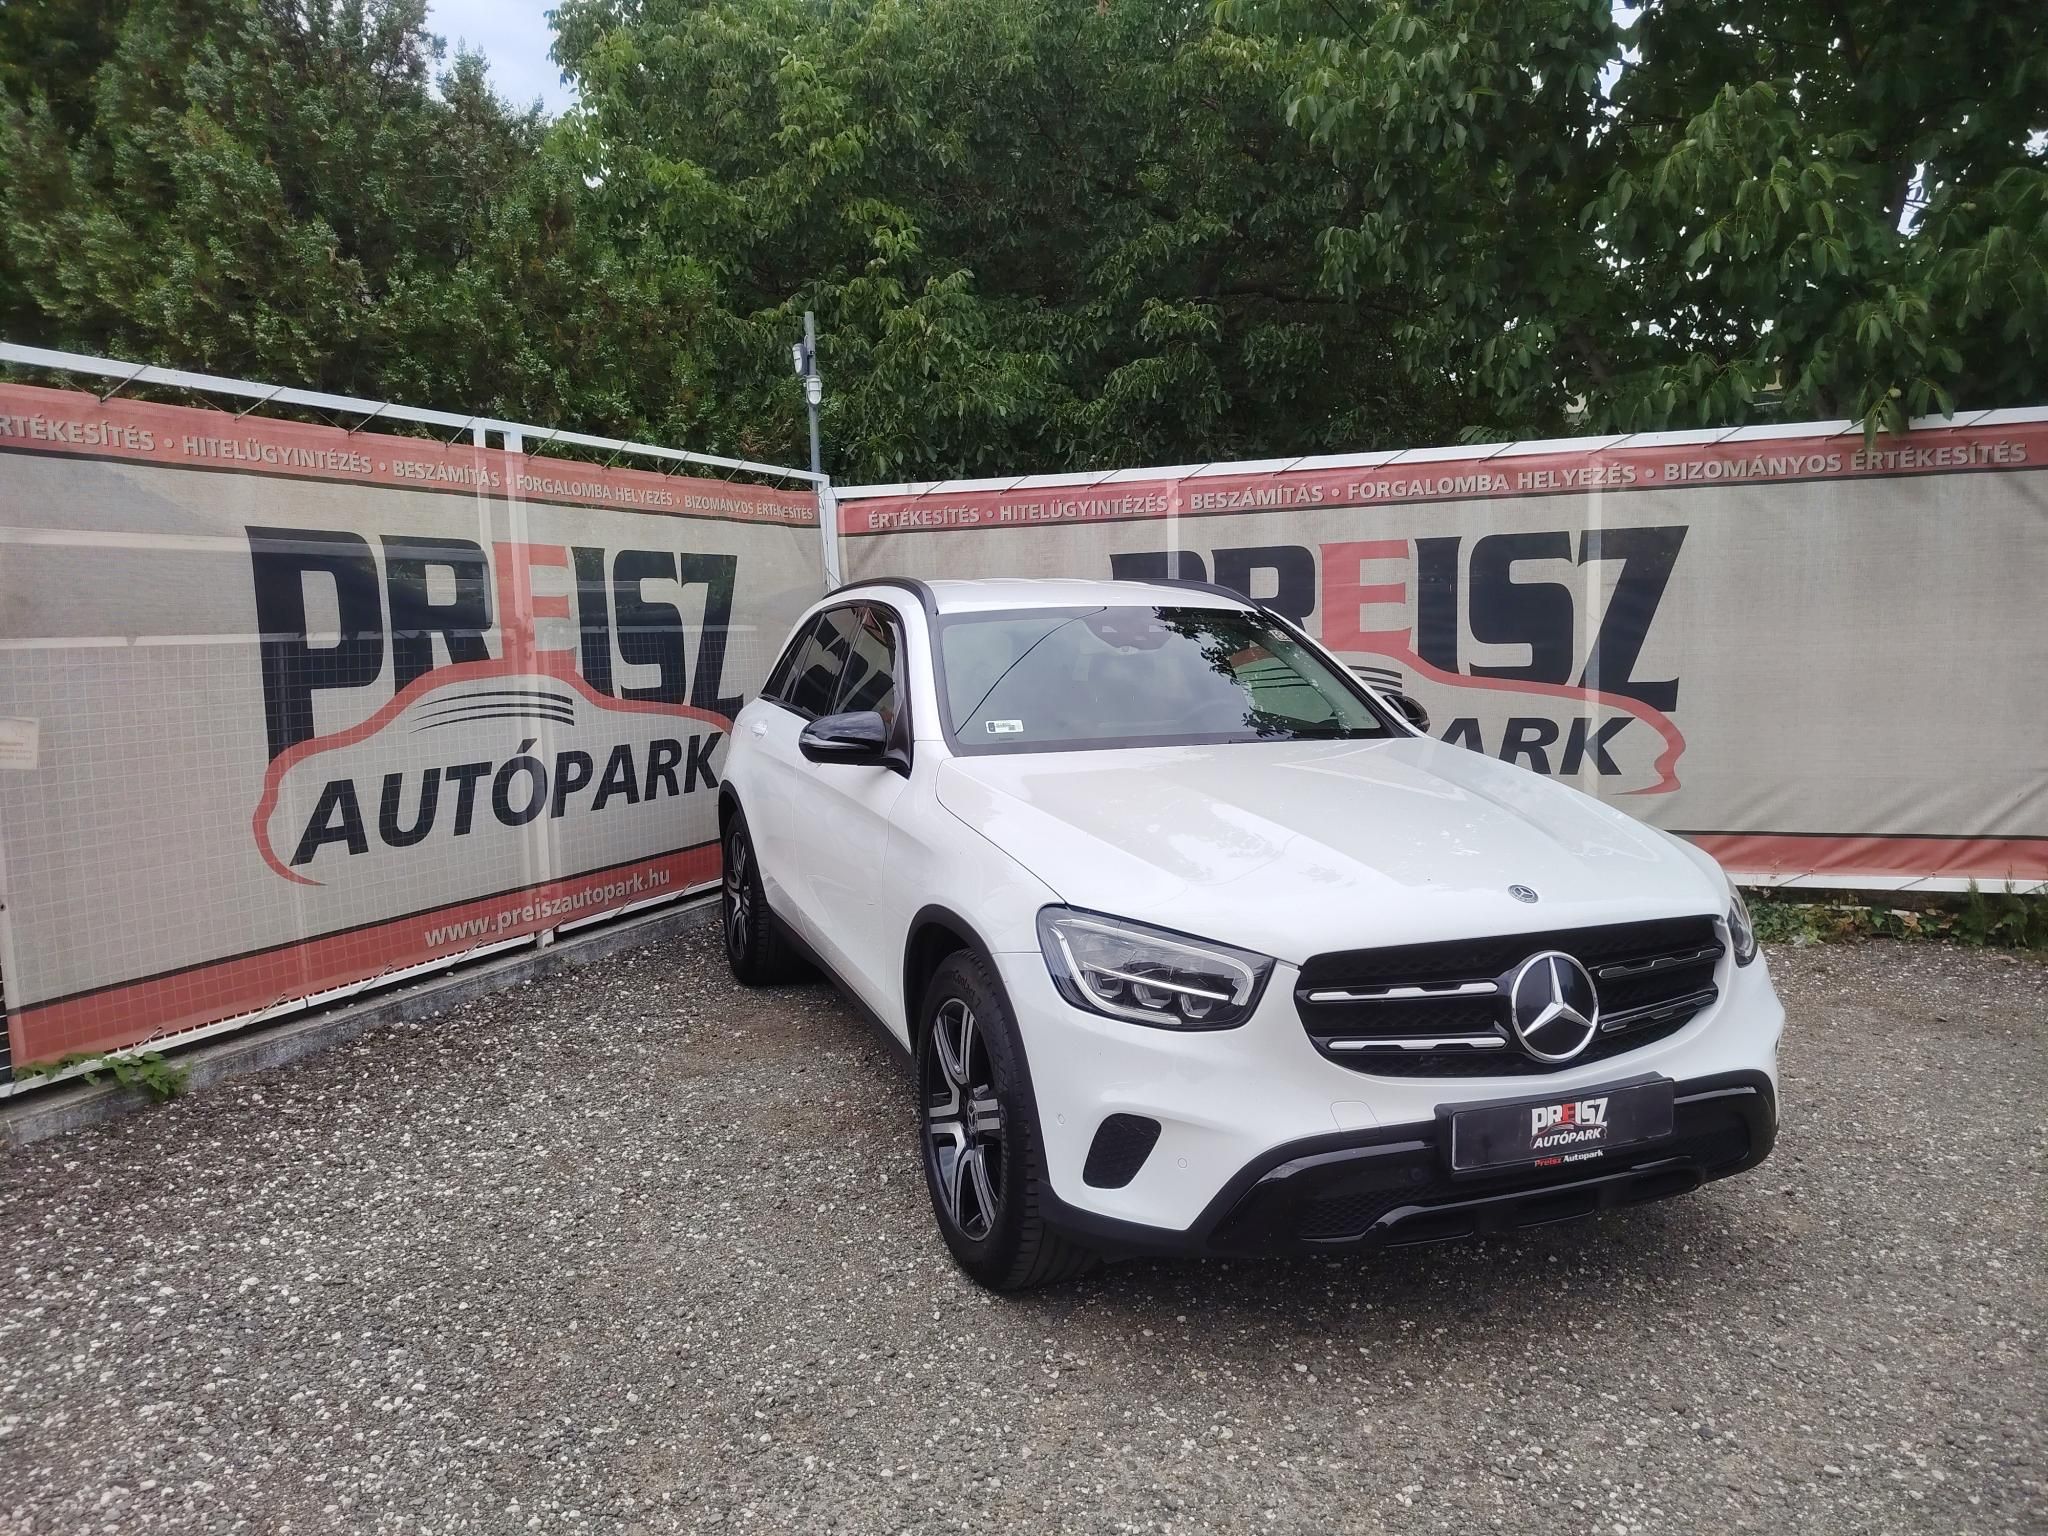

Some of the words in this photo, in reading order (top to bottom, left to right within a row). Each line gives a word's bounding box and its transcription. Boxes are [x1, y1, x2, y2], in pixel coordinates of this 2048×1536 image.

[0, 414, 155, 451] RTÉKESÍTÉS
[182, 435, 373, 474] HITELÜGYINTÉZÉS
[392, 460, 500, 488] BESZÁMÍTÁS
[516, 474, 613, 500] FORGALOMBA
[615, 487, 673, 506] HELYEZÉS
[868, 504, 980, 529] ÉRTÉKESÍTÉS
[1000, 495, 1168, 522] HITELÜGYINTÉZÉS
[1191, 482, 1324, 510] BESZÁMÍTÁS
[1348, 472, 1510, 501] FORGALOMBA
[1517, 463, 1636, 489] HELYEZÉS
[1664, 451, 1843, 481] BIZOMÁNYOS
[1850, 441, 2028, 474] ÉRTÉKESÍTÉS
[245, 525, 744, 765] PREISZ
[1110, 525, 1689, 712] REISZ
[290, 731, 724, 867] AUTÓPARK
[424, 867, 671, 948] www.preiszautopark.hu
[1531, 1097, 1609, 1137] PREISZ
[1533, 1128, 1602, 1149] AUTÓPARK
[1562, 1149, 1604, 1163] Autopark
